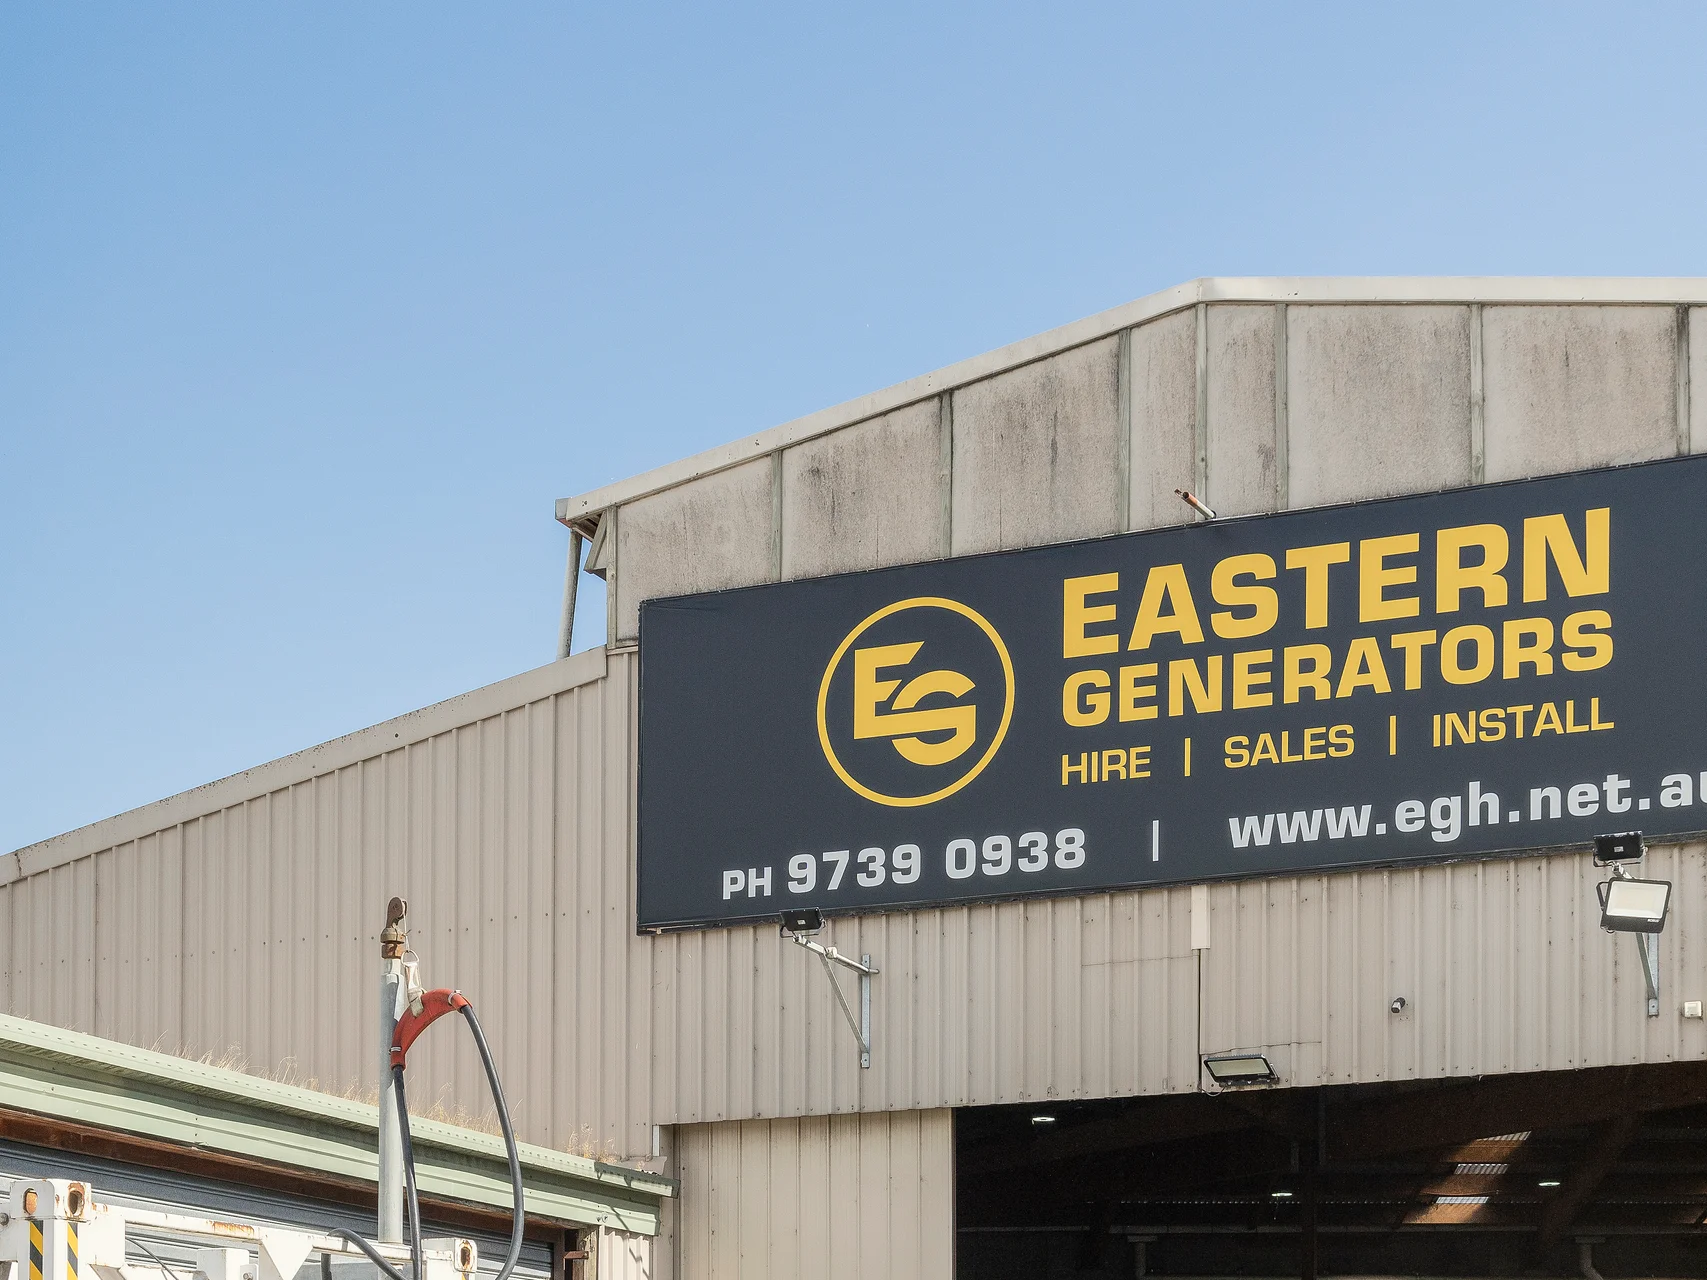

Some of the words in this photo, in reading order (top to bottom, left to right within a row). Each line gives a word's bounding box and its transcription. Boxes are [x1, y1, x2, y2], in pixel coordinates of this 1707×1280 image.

[1063, 506, 1610, 659] EASTERN
[1061, 609, 1614, 728] GENERATORS
[1061, 745, 1151, 786] HIRE
[1224, 724, 1355, 769] SALES
[1433, 697, 1615, 747] INSTALL
[1228, 770, 1707, 849] www.egh.net.a
[722, 866, 772, 900] PH
[787, 843, 922, 894] 9739
[945, 827, 1086, 880] 0938
